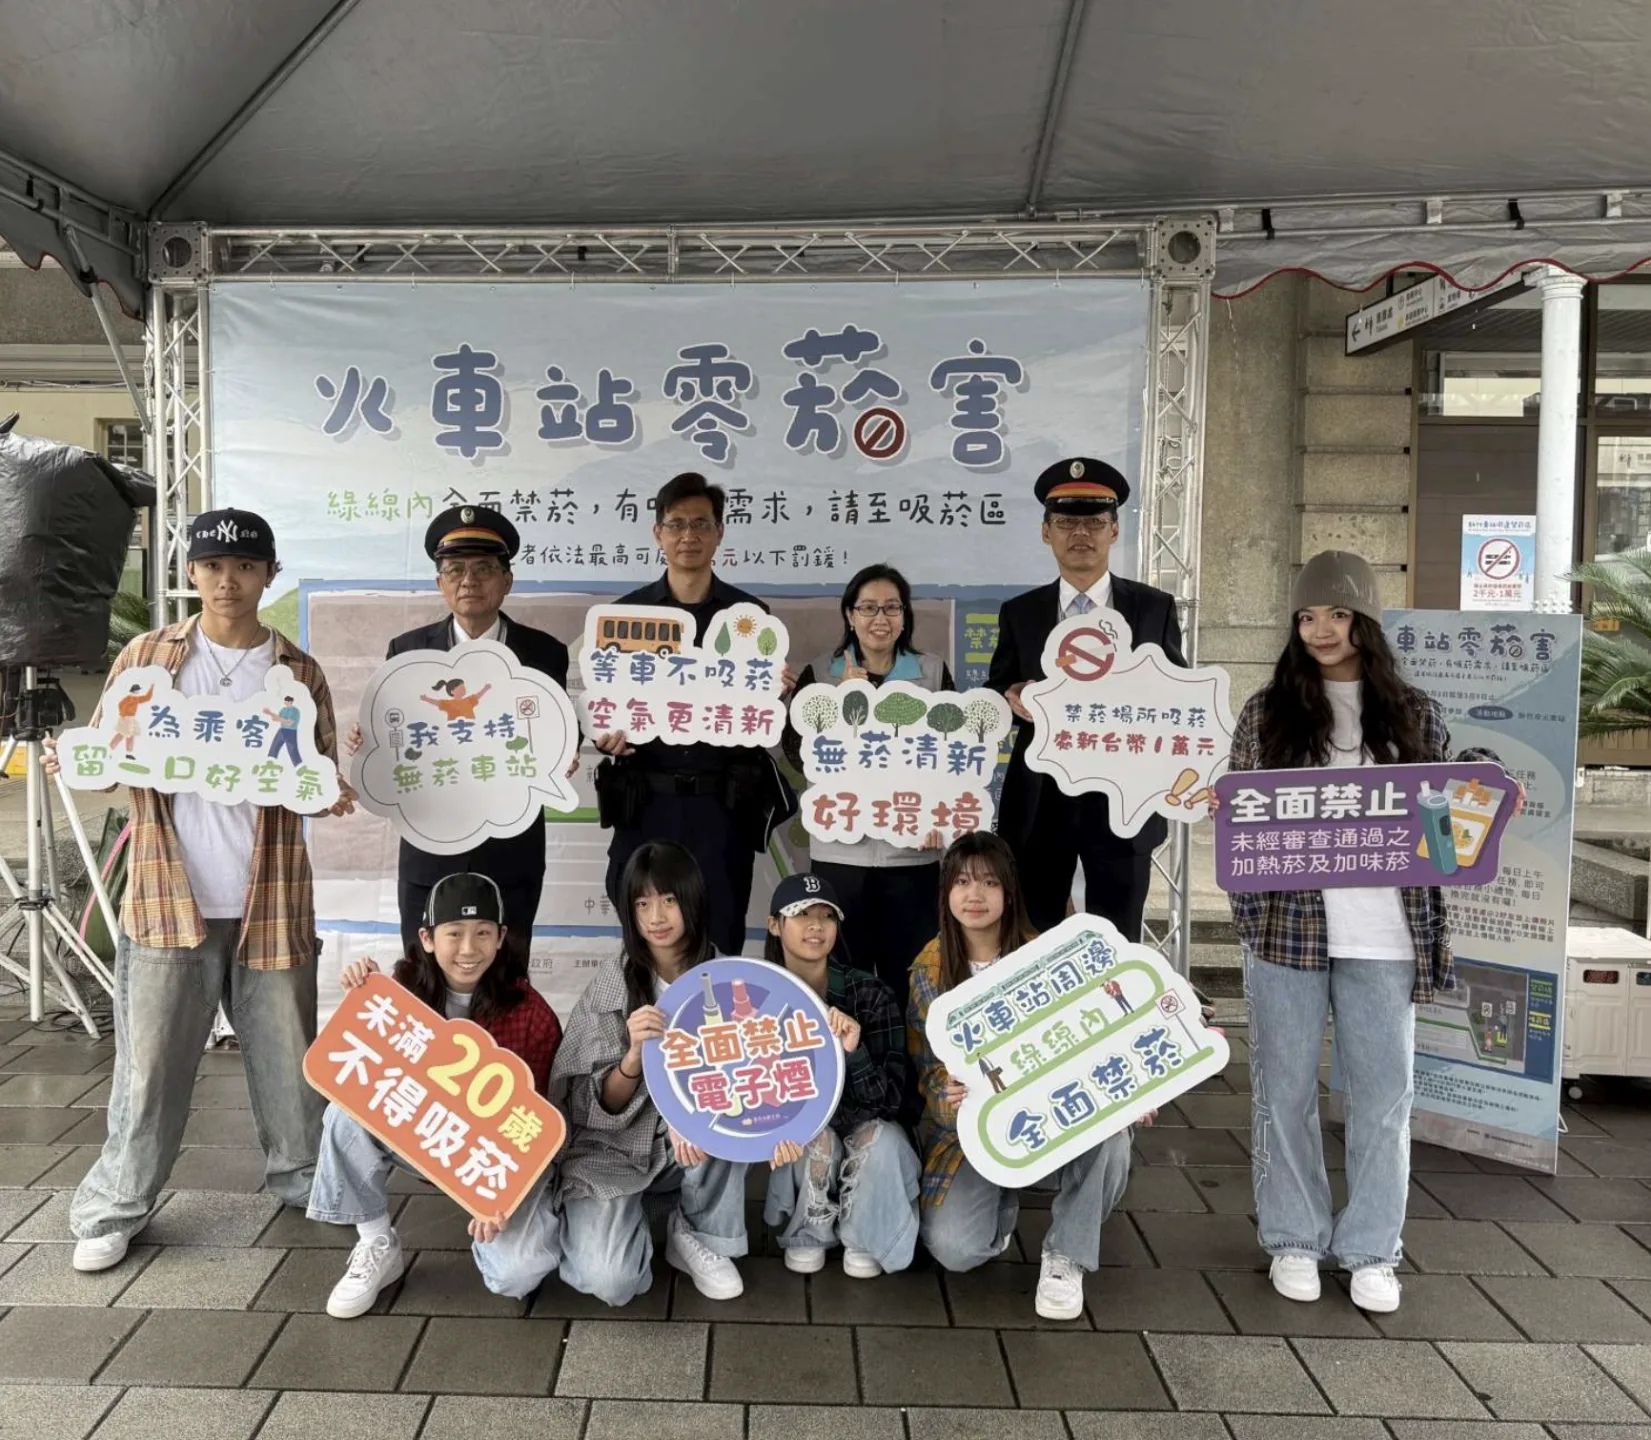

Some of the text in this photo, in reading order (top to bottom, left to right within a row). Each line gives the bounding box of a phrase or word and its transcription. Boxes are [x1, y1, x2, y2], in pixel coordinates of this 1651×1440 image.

[314, 323, 1024, 467] 火車站零菸害
[590, 651, 773, 690] 等車不吸菸
[149, 705, 269, 748] 為乘客
[407, 713, 515, 748] 我支持
[588, 698, 774, 735] 空氣更清新
[1065, 703, 1206, 728] 禁菸場所吸菸
[72, 745, 323, 800] 留一口好空氣
[393, 754, 537, 794] 無菸車站
[812, 730, 986, 776] 無菸清新
[813, 791, 982, 839] 好環境
[1230, 782, 1409, 823] 全面禁止
[1231, 827, 1411, 852] 未經審查通過之
[803, 876, 821, 892] B
[1231, 852, 1410, 877] 加熱菸及加味菸
[952, 939, 1117, 1052] 火車站周邊
[661, 1009, 825, 1070] 全面禁止
[1009, 1006, 1109, 1076] 綠線內
[357, 994, 544, 1153] 未滿20歲
[689, 1058, 817, 1111] 電子煙
[1007, 1025, 1182, 1150] 全面禁菸
[328, 1030, 519, 1200] 不得吸菸
